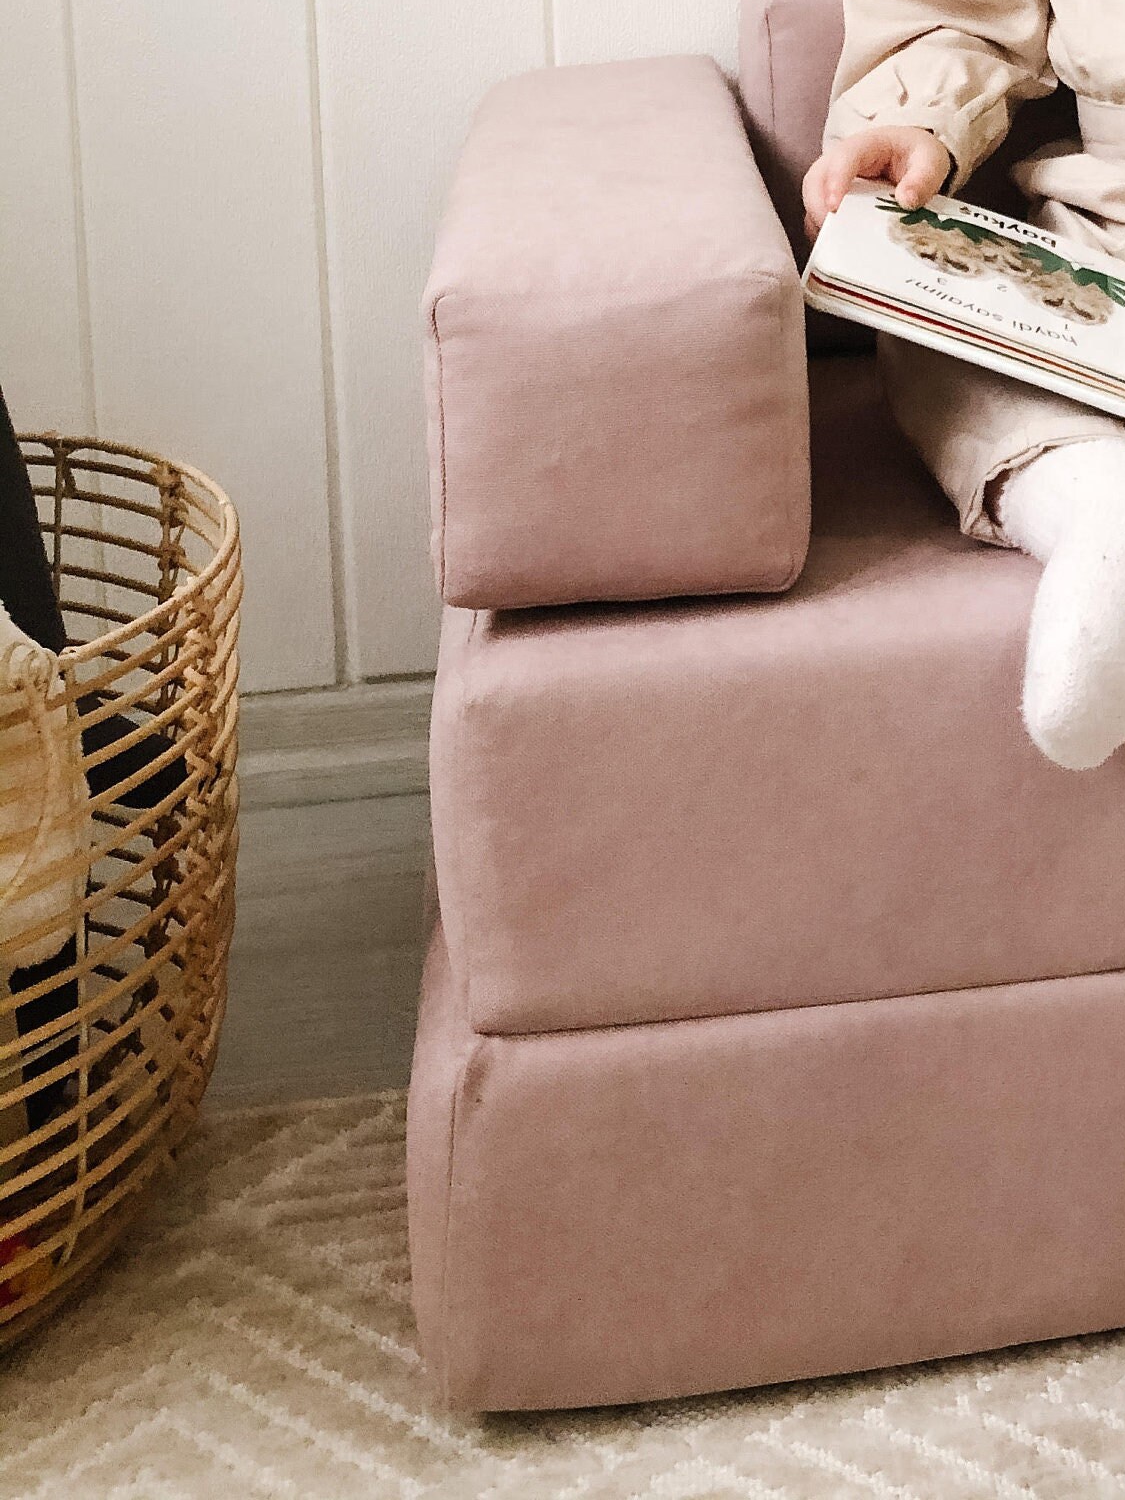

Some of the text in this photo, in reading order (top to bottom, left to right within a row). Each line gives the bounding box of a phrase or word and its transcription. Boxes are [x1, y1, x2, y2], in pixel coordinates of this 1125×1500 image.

[959, 205, 1056, 248] baykuş
[996, 283, 1008, 293] 2
[1012, 320, 1078, 347] haydi
